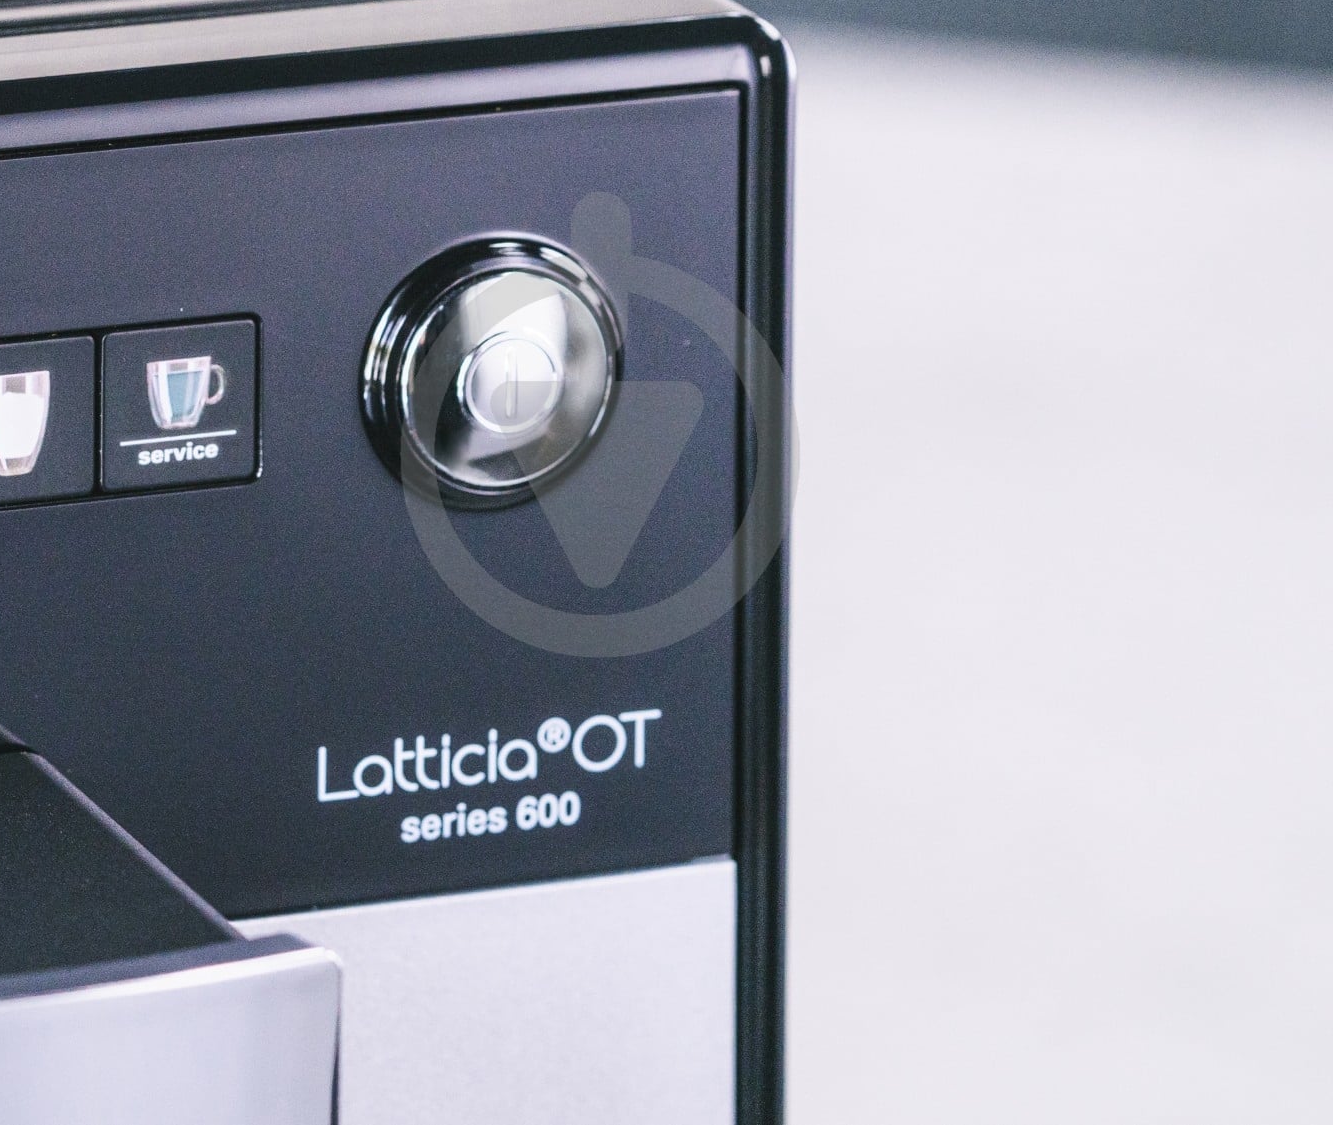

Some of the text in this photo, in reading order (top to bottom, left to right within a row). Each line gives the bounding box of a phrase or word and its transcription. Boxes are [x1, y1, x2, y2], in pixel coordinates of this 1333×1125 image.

[138, 441, 219, 466] service
[400, 790, 582, 844] series 600
